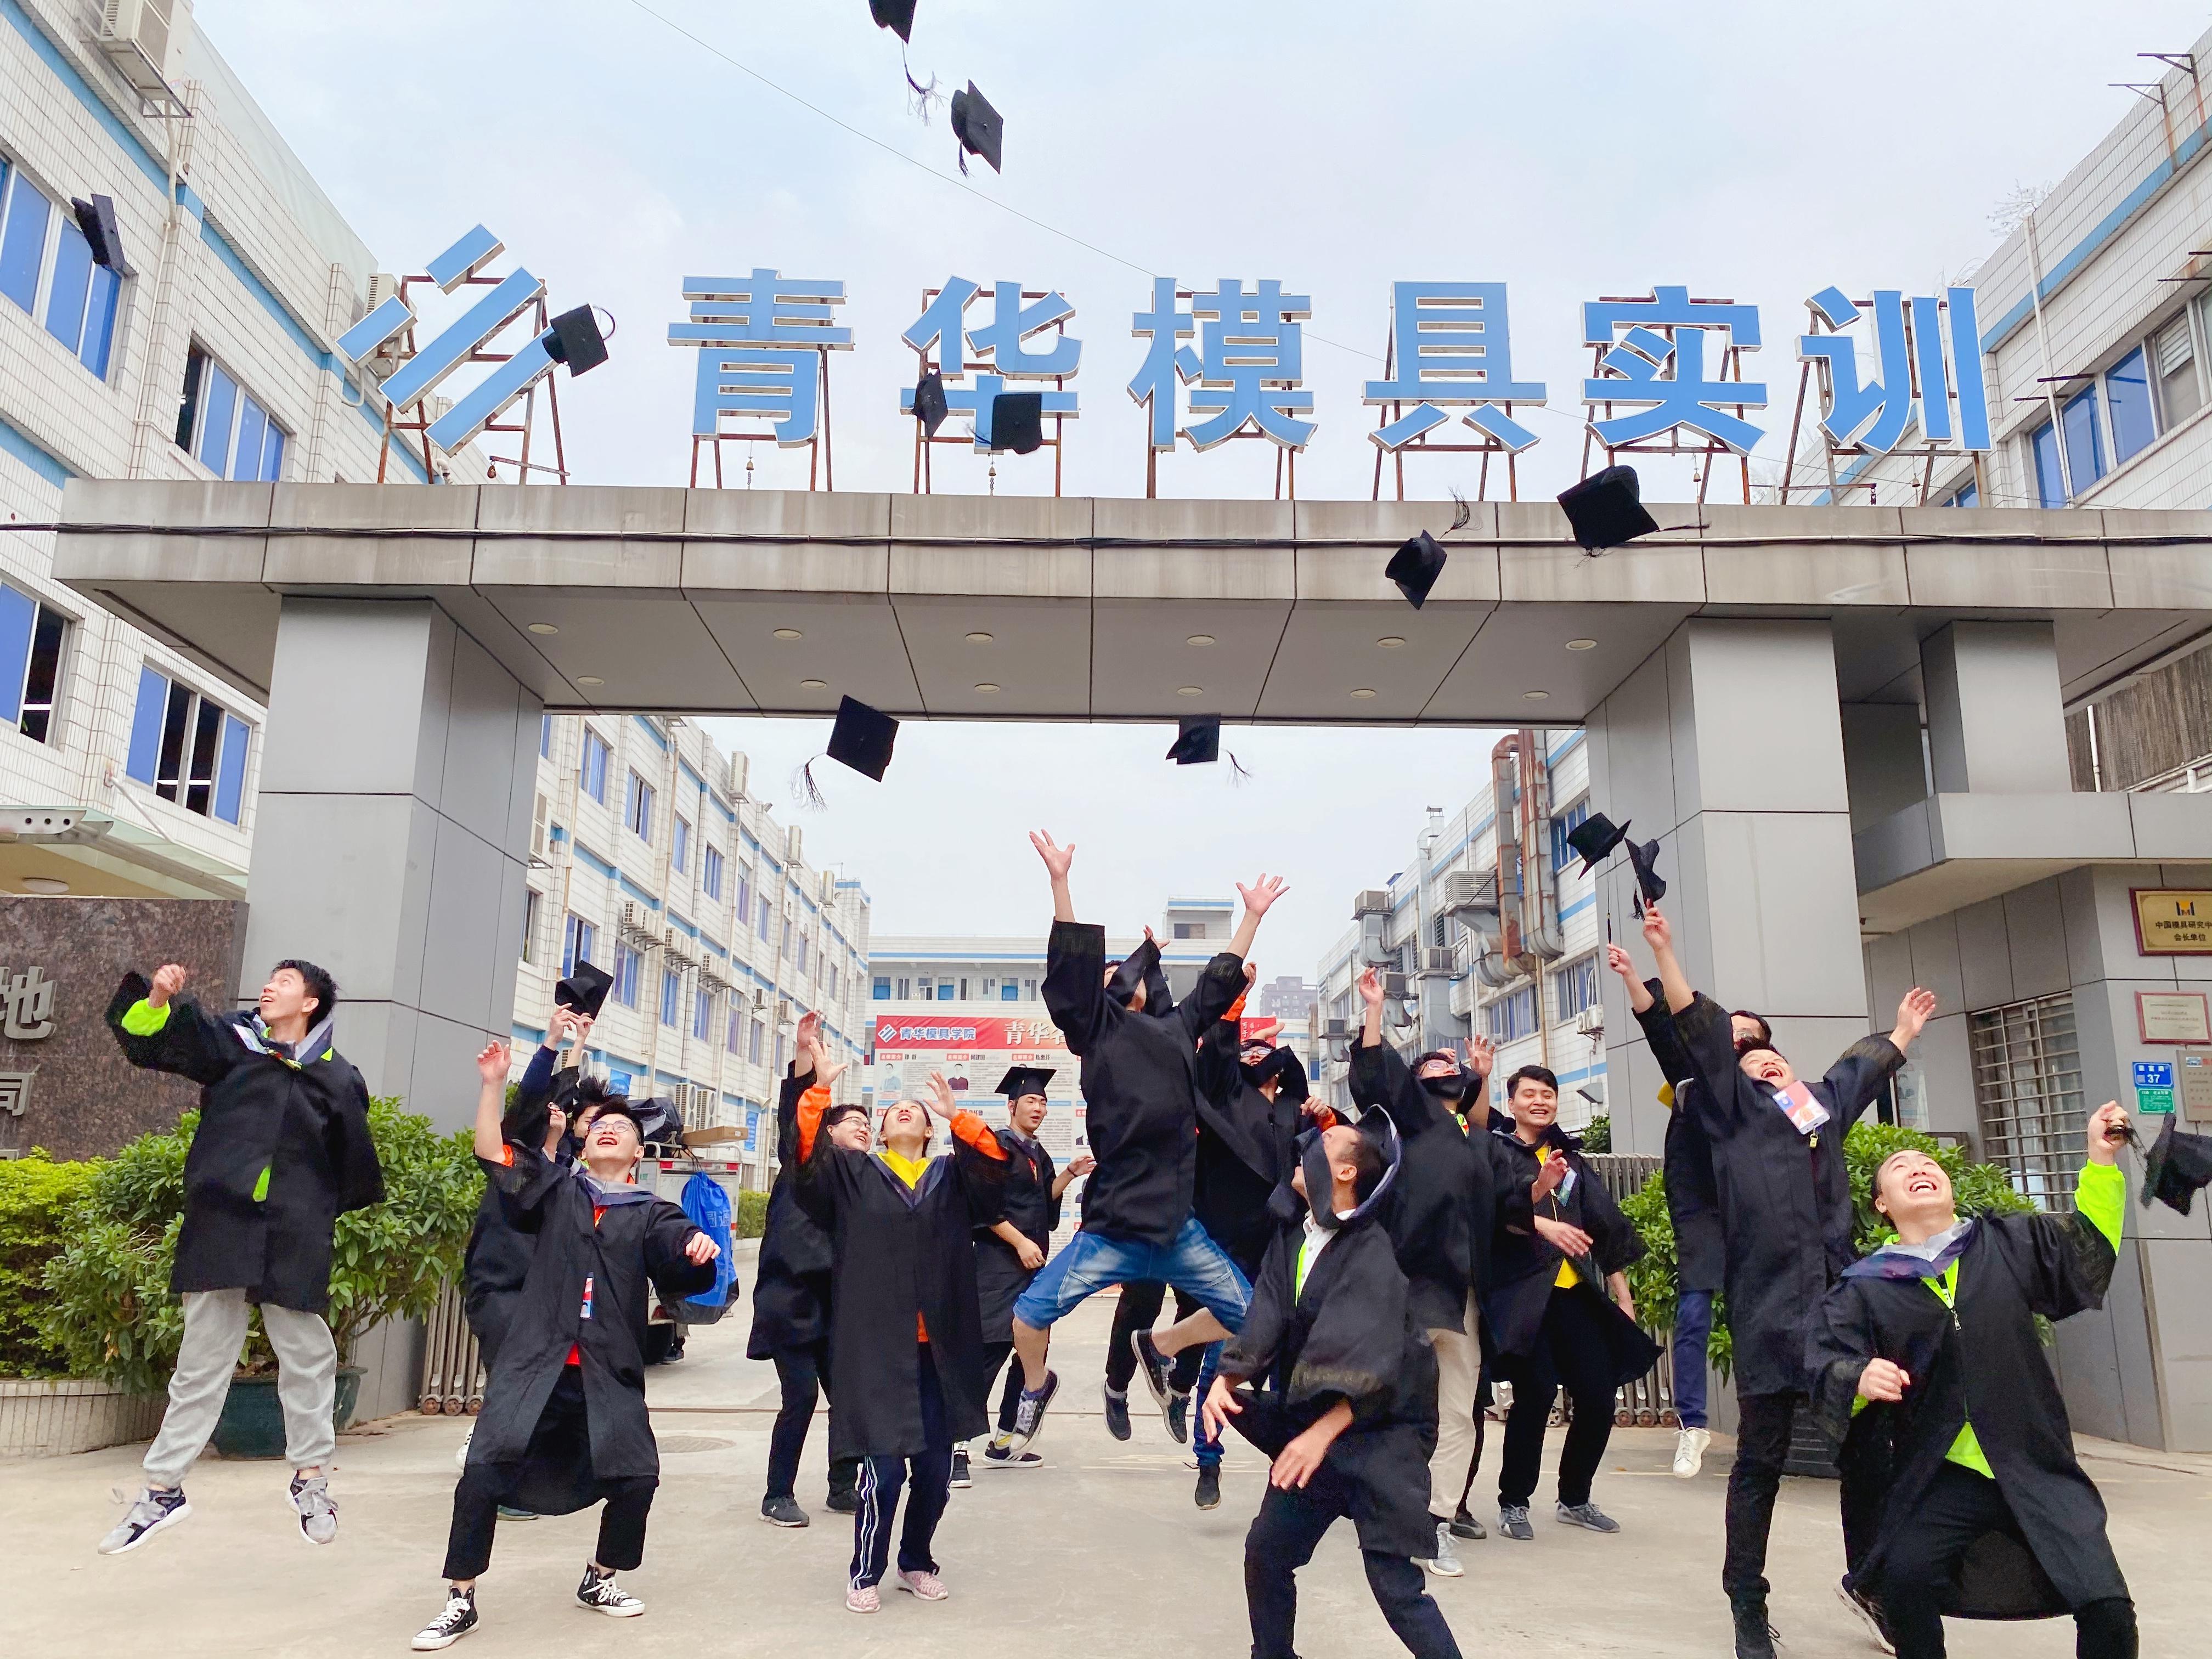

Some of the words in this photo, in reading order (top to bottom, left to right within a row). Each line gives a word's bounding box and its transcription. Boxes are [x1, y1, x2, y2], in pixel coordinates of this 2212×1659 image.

[667, 267, 1992, 456] 青华模具实训
[900, 1026, 976, 1040] 青华模具学院
[2147, 1074, 2160, 1083] 37
